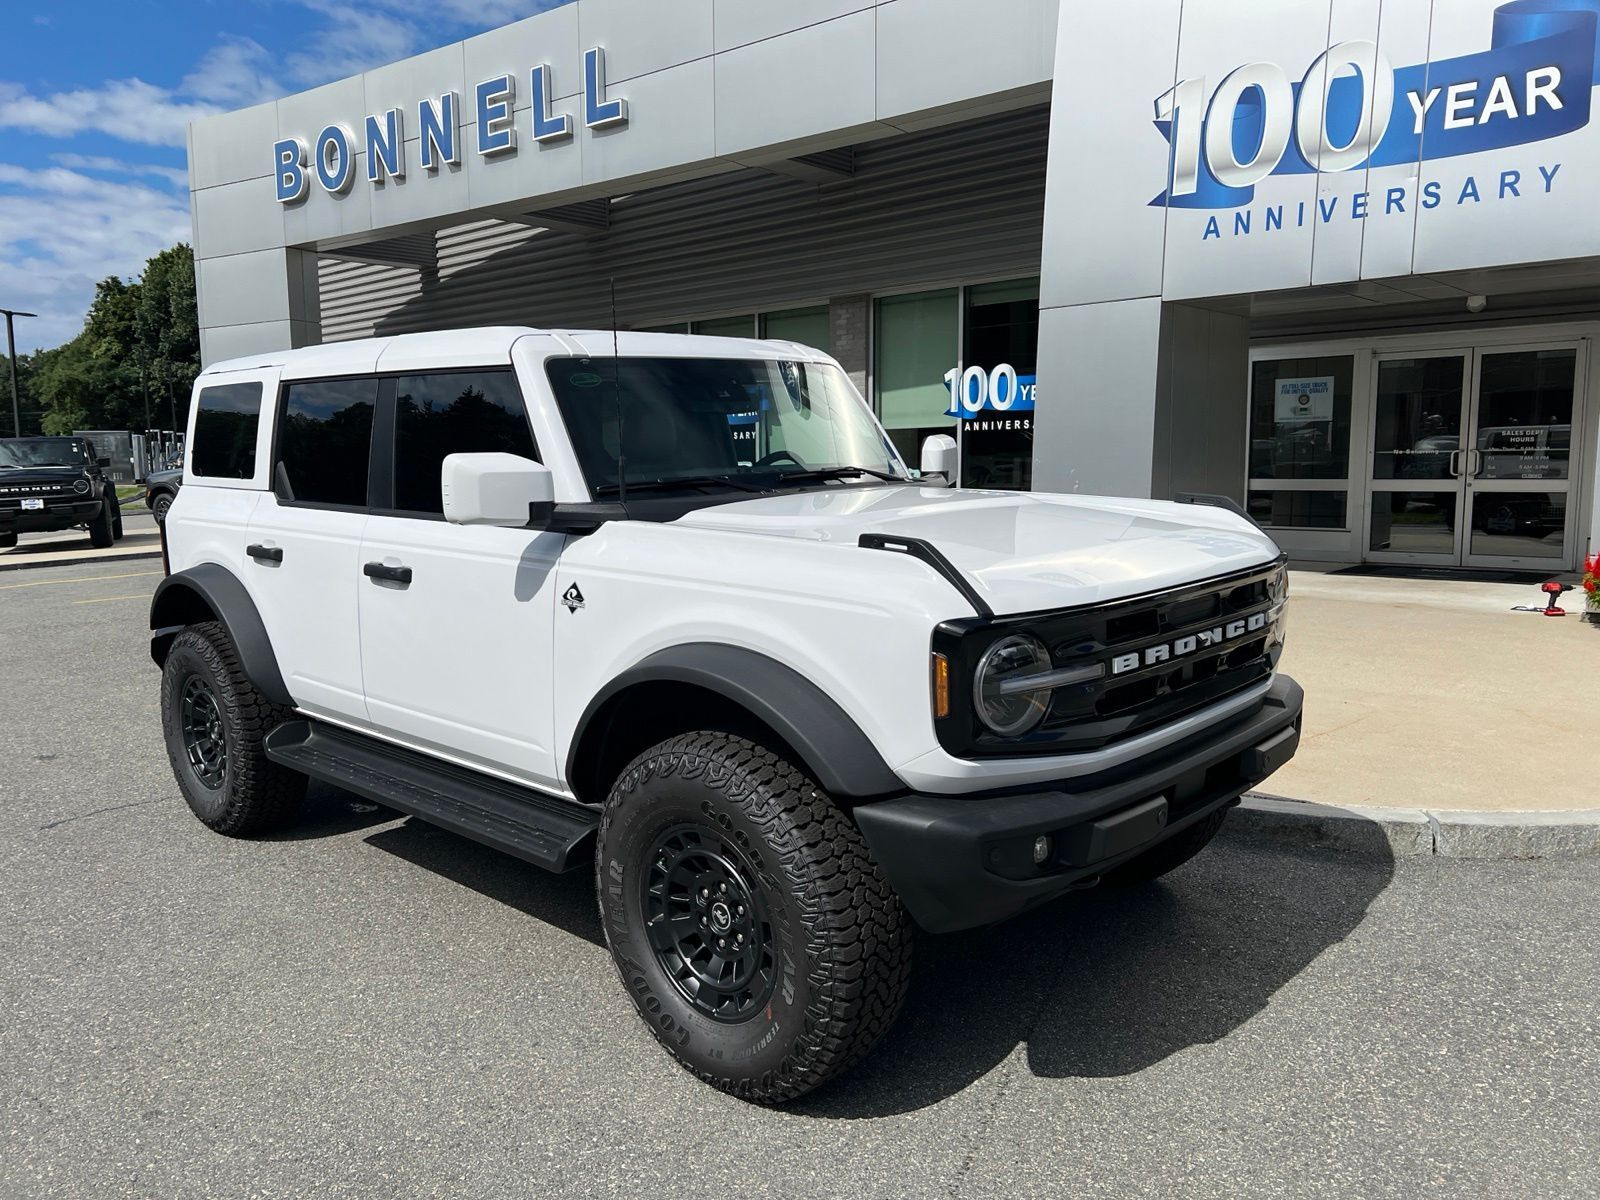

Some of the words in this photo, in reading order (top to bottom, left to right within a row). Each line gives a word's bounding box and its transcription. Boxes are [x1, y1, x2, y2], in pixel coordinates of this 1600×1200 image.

[274, 46, 628, 204] BONNELL
[1153, 40, 1394, 197] 100
[1406, 66, 1564, 134] YEAR
[1203, 163, 1562, 240] ANNIVERSARY
[943, 362, 1018, 412] 100
[964, 419, 1035, 431] ANNIVERS
[0, 485, 61, 493] BRONCO
[1111, 613, 1267, 675] BRONCO
[607, 858, 692, 1048] GOODYEAR
